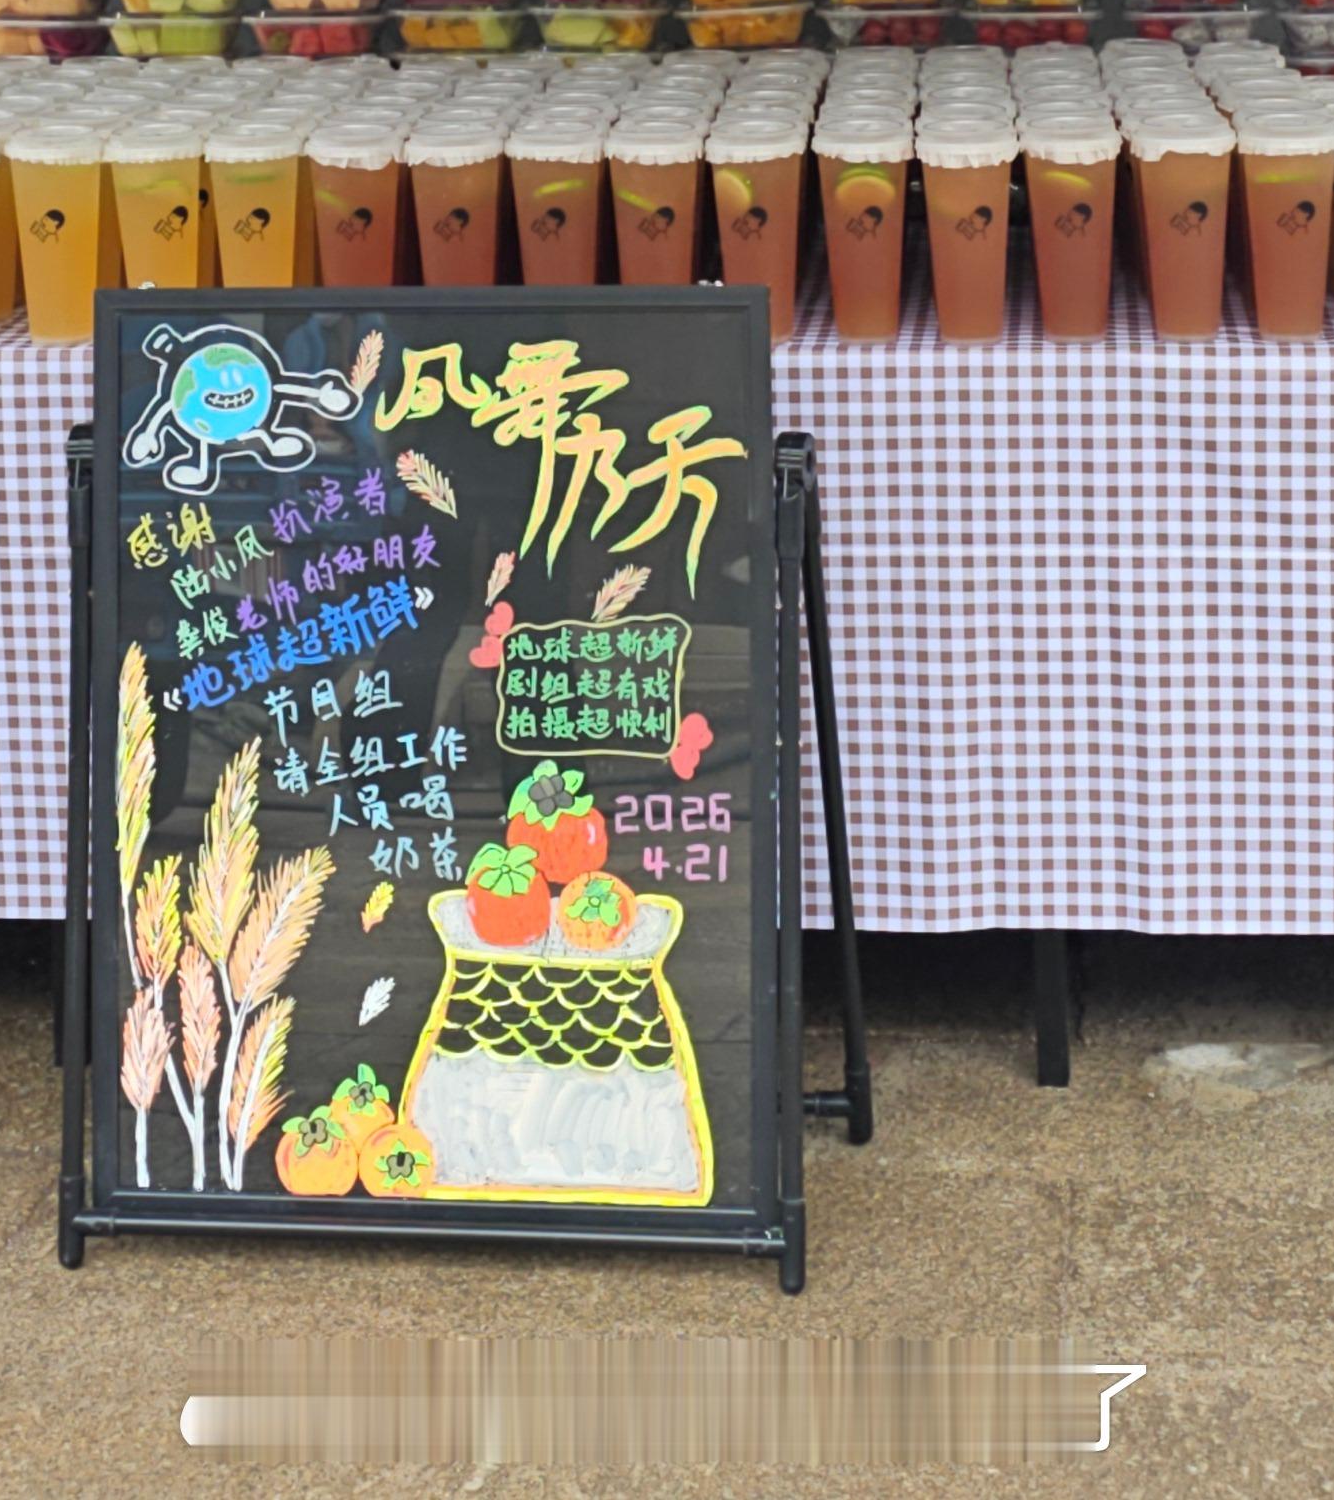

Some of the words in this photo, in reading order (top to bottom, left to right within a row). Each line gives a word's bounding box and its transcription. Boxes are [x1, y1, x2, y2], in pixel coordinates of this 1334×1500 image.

[127, 502, 216, 569] 感谢
[506, 626, 678, 665] 地球超新鲜
[263, 670, 403, 747] 节目组
[505, 667, 671, 708] 剧组超有戏
[505, 704, 672, 743] 拍摄超顺利
[274, 725, 467, 797] 请全组工作
[329, 774, 454, 837] 人员喝
[614, 792, 731, 834] 2026
[369, 827, 462, 881] 奶茶
